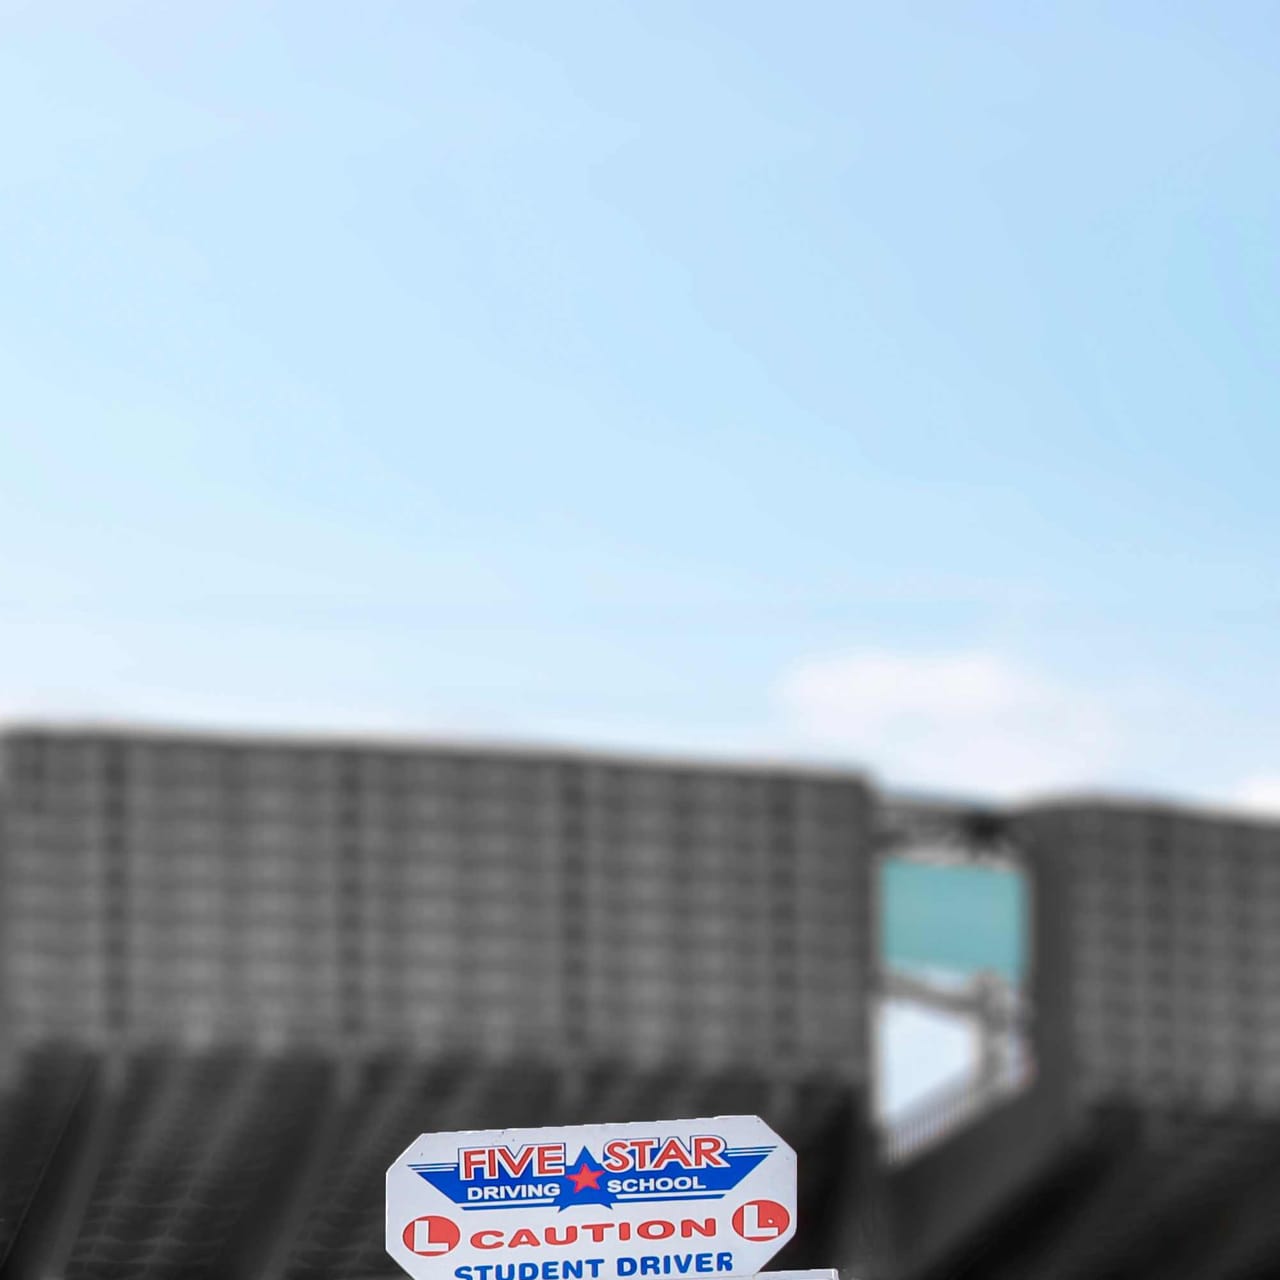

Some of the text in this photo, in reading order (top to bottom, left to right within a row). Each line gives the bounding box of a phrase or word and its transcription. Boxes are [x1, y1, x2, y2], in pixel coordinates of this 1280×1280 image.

[458, 1136, 730, 1181] FIVE STAR
[467, 1176, 707, 1201] DRIVING SCHOOL
[413, 1205, 779, 1252] L CAUTION L
[616, 1252, 733, 1276] DRIVER
